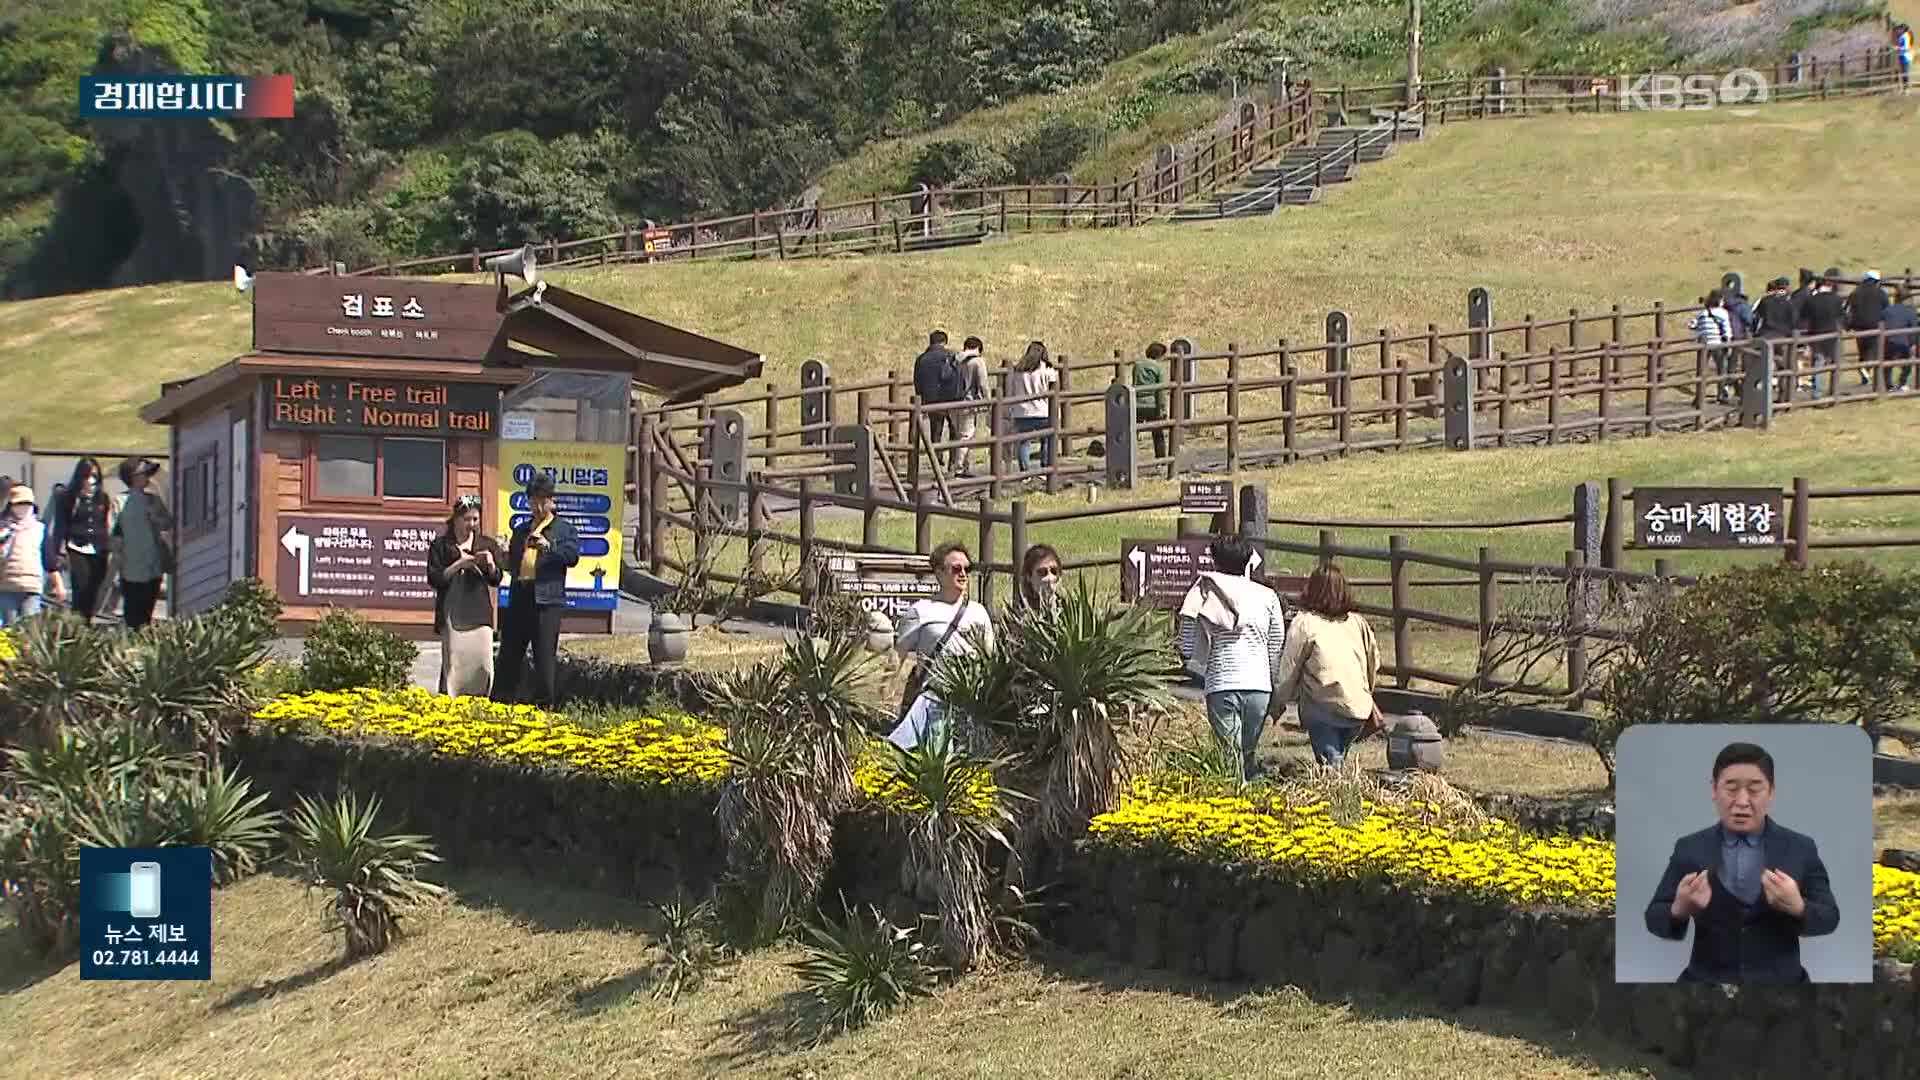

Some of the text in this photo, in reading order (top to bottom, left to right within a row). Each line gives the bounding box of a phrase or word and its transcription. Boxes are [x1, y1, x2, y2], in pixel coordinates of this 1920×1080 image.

[275, 376, 320, 400] Left
[347, 383, 396, 403] Free
[406, 385, 448, 405] trail
[275, 403, 336, 425] Right
[363, 408, 440, 429] Normal
[448, 411, 490, 431] trail
[1644, 502, 1776, 533] 승마체험장
